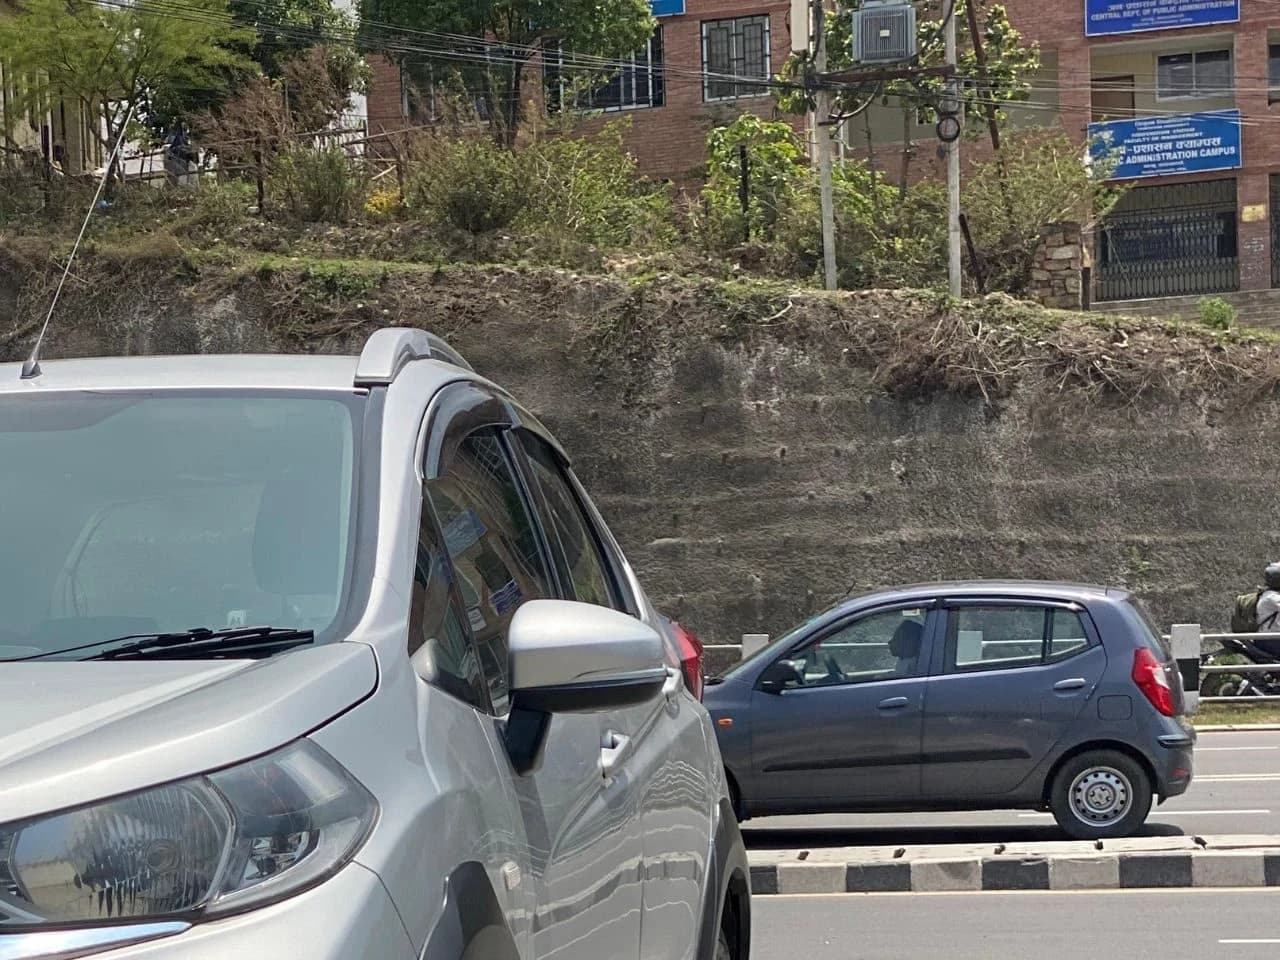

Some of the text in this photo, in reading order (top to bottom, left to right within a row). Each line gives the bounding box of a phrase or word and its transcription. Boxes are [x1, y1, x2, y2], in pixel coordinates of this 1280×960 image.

[1091, 12, 1121, 21] CENTRAL
[1179, 1, 1235, 11] ADMINISTRATION
[1126, 150, 1198, 164] ADMINISTRATION
[1199, 146, 1236, 157] CAMPUS
